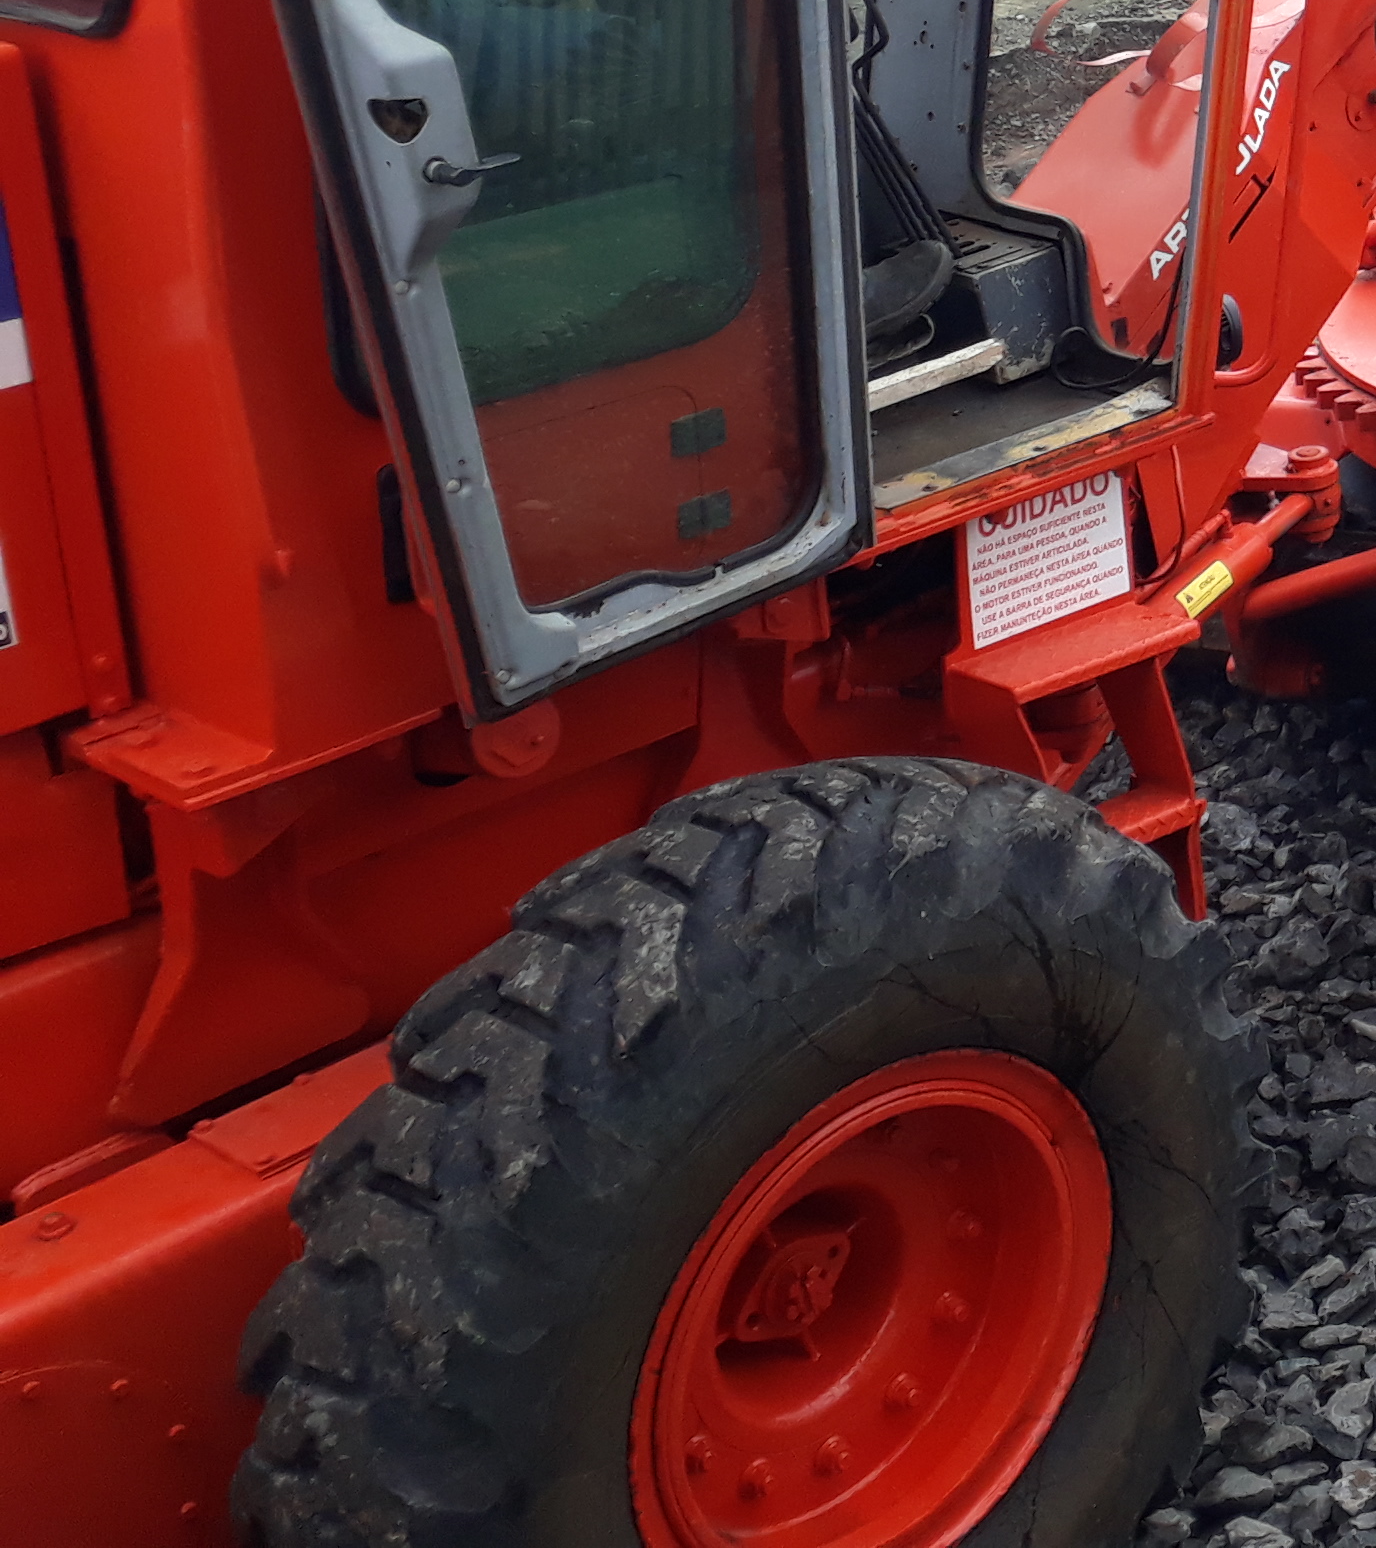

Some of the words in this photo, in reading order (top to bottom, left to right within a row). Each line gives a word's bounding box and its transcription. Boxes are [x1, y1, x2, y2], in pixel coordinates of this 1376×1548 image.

[978, 471, 1109, 537] CUIDADO
[977, 543, 993, 556] NÃO
[1008, 527, 1037, 544] ESPAÇO
[1040, 511, 1081, 532] SUFICIENTE
[1083, 502, 1106, 516] NESTA
[997, 549, 1016, 562] PARA
[1018, 543, 1034, 555] UMA
[1069, 518, 1100, 535] QUANDO
[973, 567, 1007, 585] MÁQUINA
[1009, 554, 1040, 572] ESTIVER
[979, 584, 996, 597] NÃO
[998, 567, 1045, 591] PERMANEÇA
[1046, 558, 1069, 572] NESTA
[1092, 537, 1123, 555] QUANDO
[977, 626, 999, 641] FIZER
[1054, 597, 1077, 611] NESTA
[982, 612, 996, 625] USE
[1006, 600, 1032, 616] BARRA
[1033, 595, 1044, 605] DE
[1045, 578, 1091, 601] SEGURANÇA
[1092, 565, 1123, 583] QUANDO
[982, 594, 1009, 609] MOTOR
[1011, 582, 1042, 599] ESTIVER
